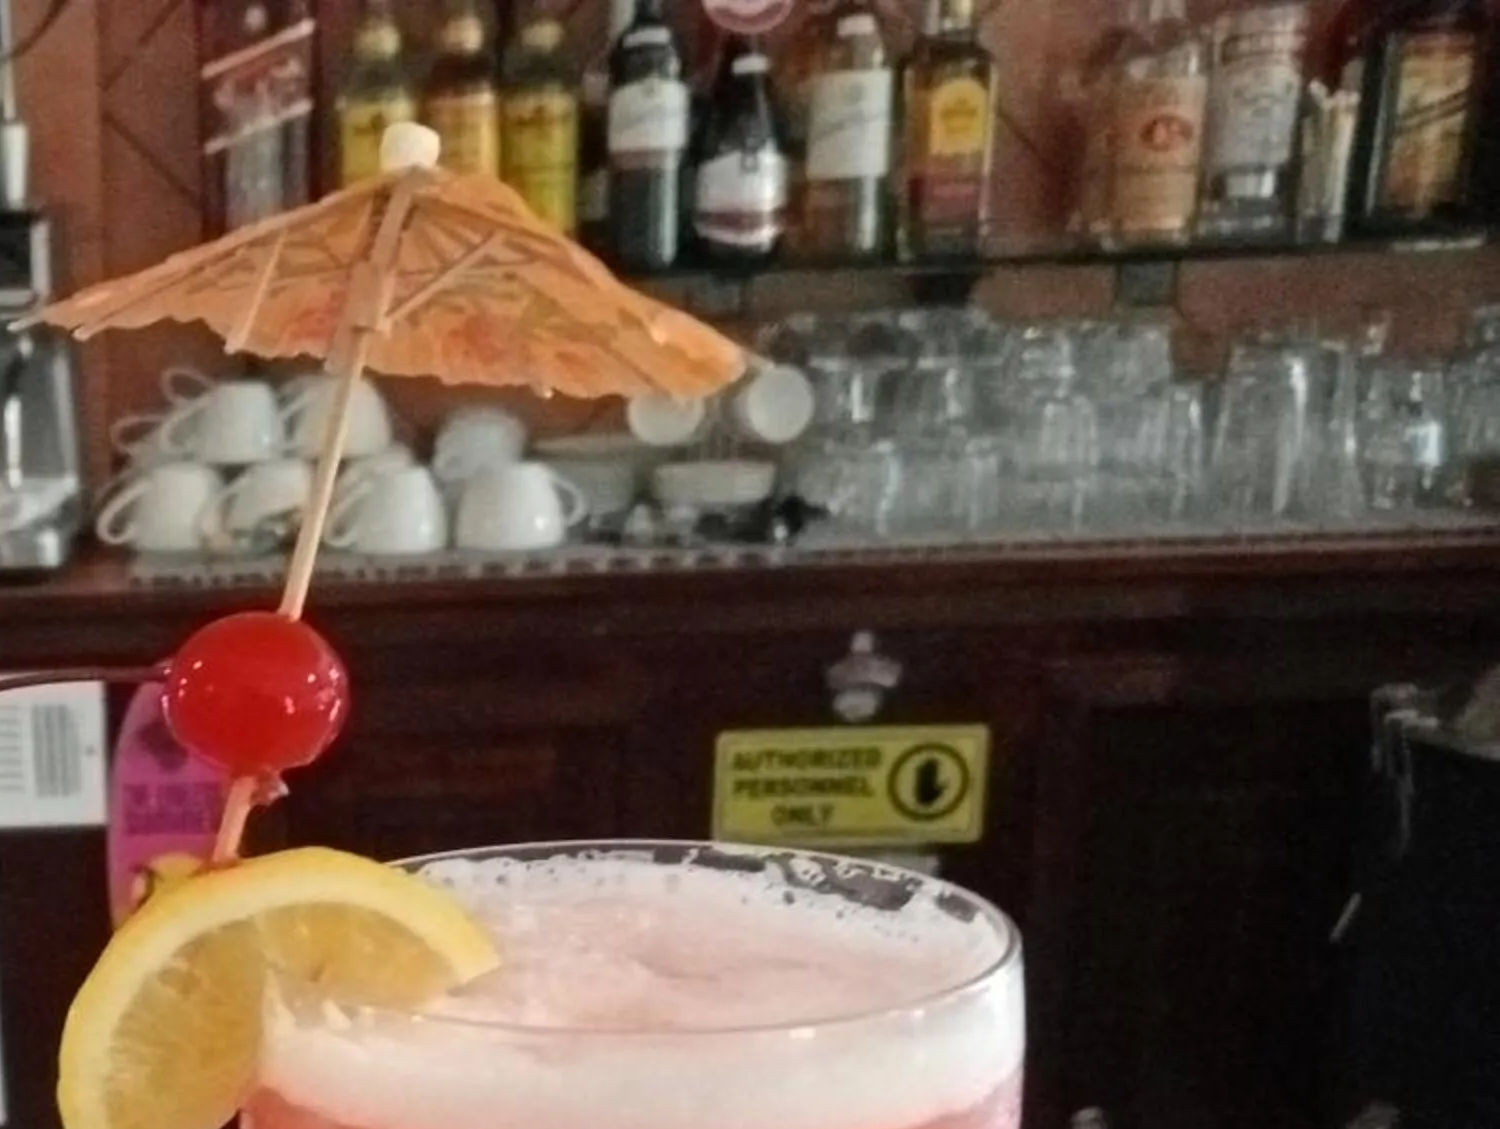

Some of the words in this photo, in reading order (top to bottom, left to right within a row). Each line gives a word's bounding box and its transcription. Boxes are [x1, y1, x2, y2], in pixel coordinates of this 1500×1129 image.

[732, 746, 882, 772] AUTHORIZED
[732, 775, 875, 800] PERSONNEL
[770, 803, 837, 827] ONLY
